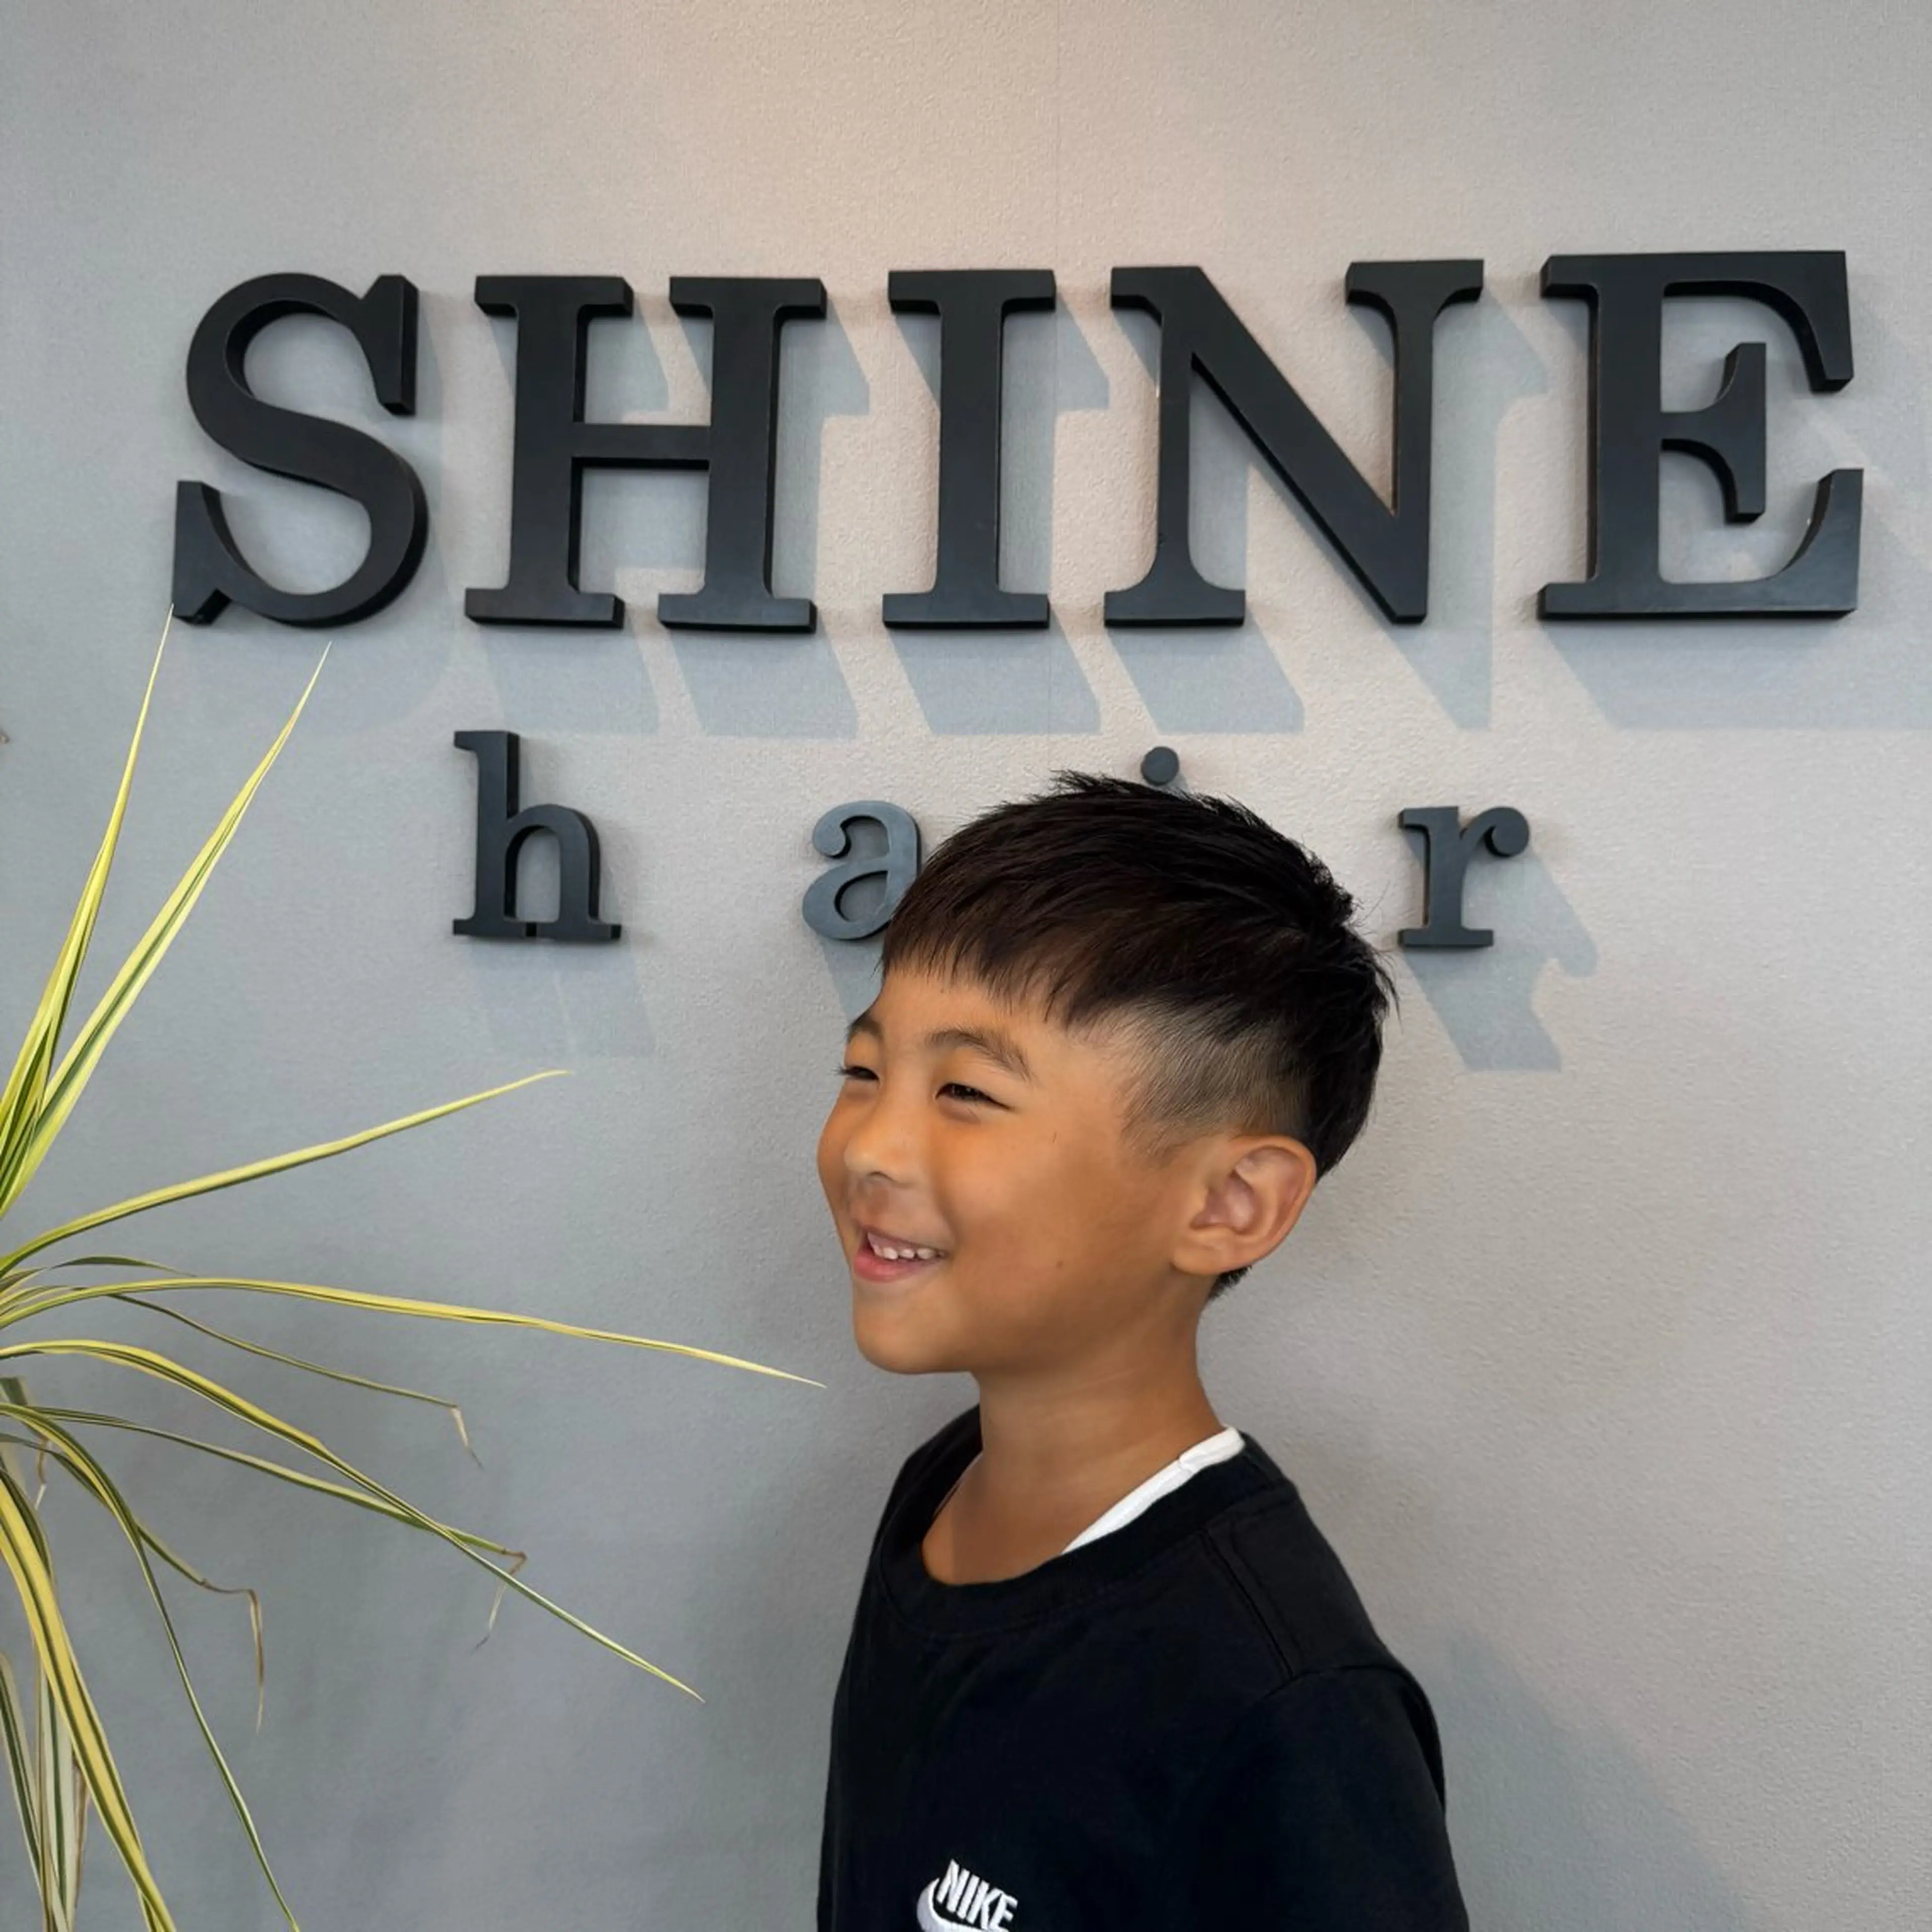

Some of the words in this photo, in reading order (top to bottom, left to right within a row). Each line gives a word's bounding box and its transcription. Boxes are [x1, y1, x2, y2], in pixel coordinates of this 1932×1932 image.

[173, 251, 1861, 628] SHINE
[453, 731, 1529, 949] har
[936, 1859, 1018, 1932] NIKE
